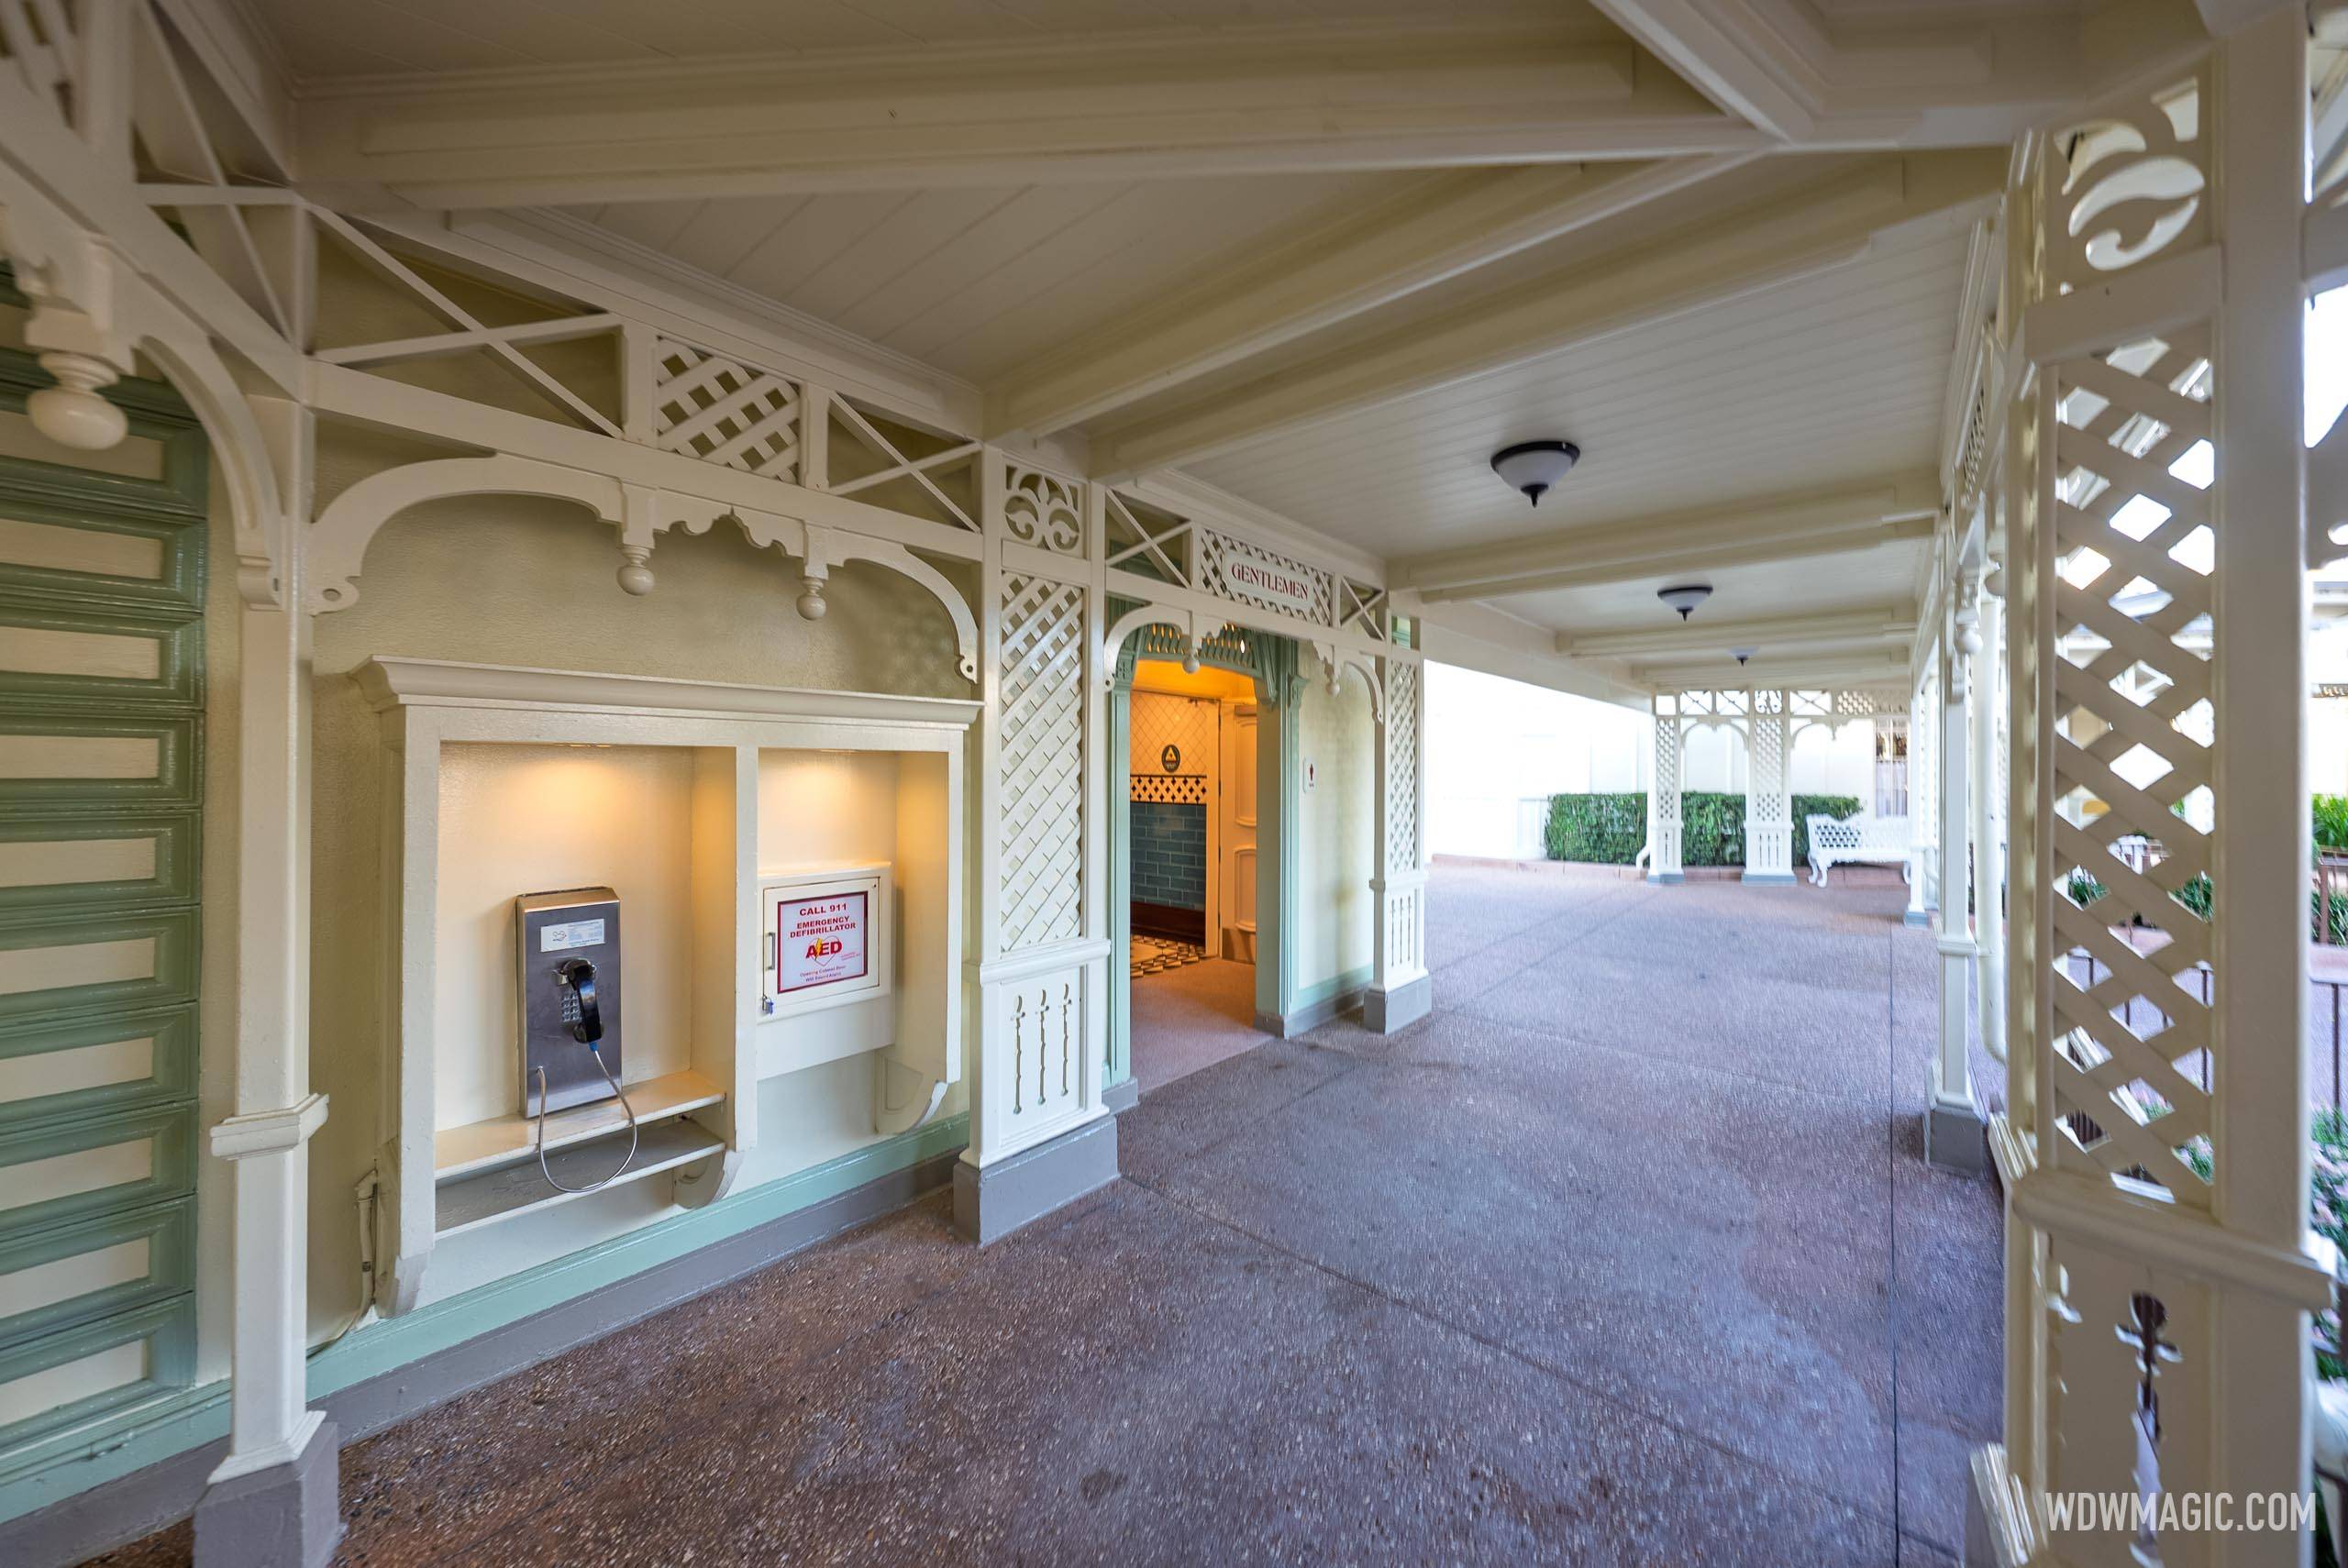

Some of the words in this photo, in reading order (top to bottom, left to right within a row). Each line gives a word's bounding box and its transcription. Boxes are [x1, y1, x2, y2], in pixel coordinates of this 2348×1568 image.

[1231, 561, 1308, 601] GENTLEMEN
[799, 906, 826, 916] CALL
[829, 903, 847, 912] 911
[790, 922, 856, 938] DEFIBRILLATOR
[796, 915, 850, 930] EMERGENCY
[805, 941, 843, 959] AED
